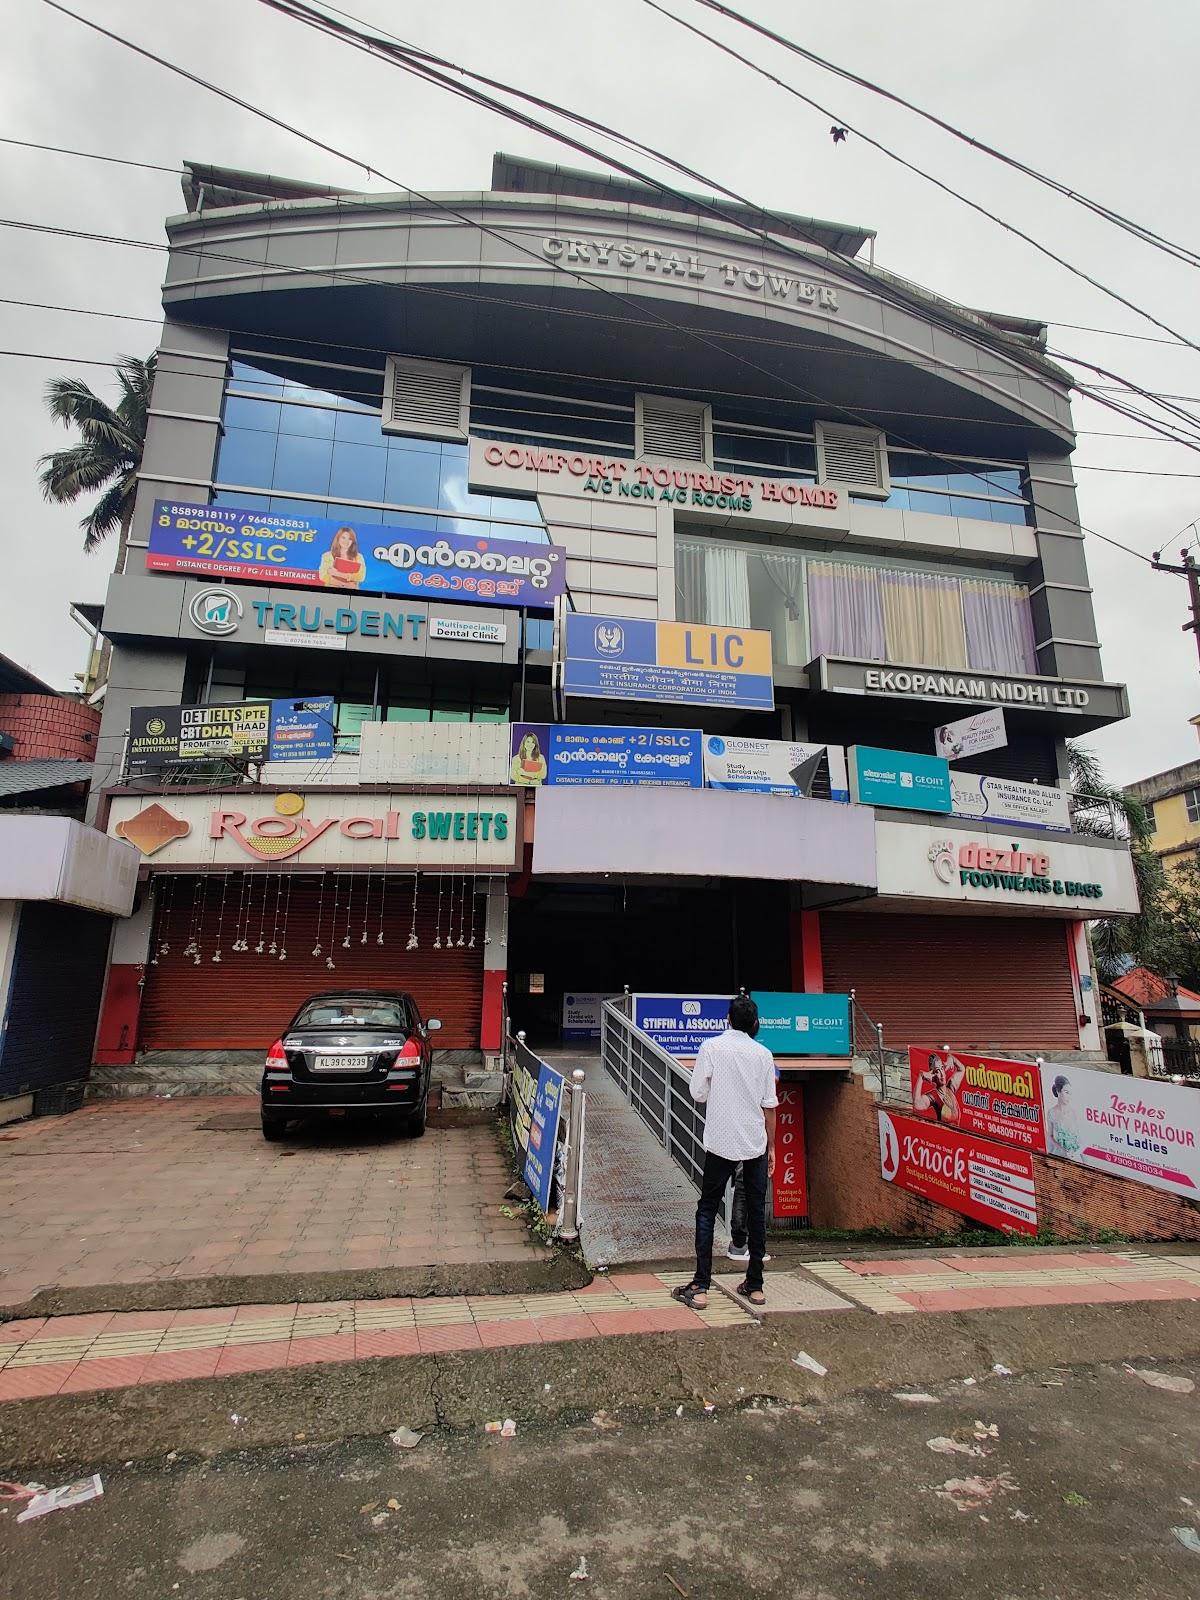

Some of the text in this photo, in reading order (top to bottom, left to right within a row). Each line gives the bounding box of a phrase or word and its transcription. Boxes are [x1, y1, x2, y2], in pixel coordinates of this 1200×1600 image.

[543, 236, 840, 312] CRYSTAL TOWER
[484, 444, 839, 510] COMFORT TOURIST HOME
[584, 477, 753, 513] A/C NON A/C ROOMS
[171, 506, 237, 527] 8589818119
[248, 515, 311, 530] 9645835831
[158, 515, 318, 545] 8 മാസം കൊണ്ട്
[181, 532, 289, 563] +2/SSLC
[176, 560, 212, 570] DISTANCE
[213, 563, 241, 574] DEGREE
[247, 566, 258, 575] PG
[280, 569, 316, 580] ENTRANCE
[409, 571, 525, 597] കോളേജ്
[252, 600, 426, 640] TRU-DENT
[437, 620, 499, 633] Multispeciality
[437, 628, 499, 641] Dental Clinic
[685, 630, 744, 667] LIC
[600, 671, 737, 690] भारतीय जीवन बीमा निगम
[865, 670, 1090, 707] EKOPANAM NIDHI LTD
[616, 681, 657, 690] INSURANCE
[657, 684, 706, 694] CORPORATION
[718, 689, 737, 697] INDIA
[183, 708, 266, 724] OET IELTS PTE
[180, 725, 233, 739] CBT DHA
[236, 722, 266, 732] HAAD
[962, 726, 1001, 741] BEAUTY PARLOUR
[132, 736, 178, 748] AJINORAH
[655, 735, 691, 747] SSLC
[726, 740, 769, 751] GLOBNEST
[978, 734, 994, 742] LADIES
[131, 744, 178, 754] INSTITUTIONS
[248, 745, 263, 753] BLS
[633, 751, 693, 767] കോളേജ്
[727, 762, 746, 770] Study
[556, 776, 583, 784] DISTANCE
[584, 777, 605, 785] DEGREE
[915, 775, 944, 786] GEOJIT
[954, 790, 983, 805] STAR
[986, 782, 1061, 800] STAR HEALTH AND ALLIED
[997, 791, 1032, 804] INSURANCE
[411, 810, 508, 841] SWEETS
[209, 811, 401, 861] Royal
[959, 841, 1050, 876] dezire
[960, 870, 1104, 899] FOOTWEARS & BAGS
[642, 1017, 677, 1030] STIFFIN
[678, 1019, 685, 1030] &
[812, 1018, 844, 1026] GEOJIT
[652, 1034, 688, 1043] Chartered
[320, 1057, 366, 1067] KL 39 C 9239
[1110, 1094, 1166, 1121] Lashes
[972, 1117, 1033, 1145] PH: 9048097755
[1086, 1107, 1196, 1148] BEAUTY PARLOUR
[779, 1089, 797, 1185] Knock
[1109, 1133, 1124, 1144] For
[1126, 1133, 1168, 1156] Ladies
[902, 1135, 967, 1184] Knock
[906, 1165, 924, 1181] Boutique
[928, 1174, 950, 1192] Stitching
[950, 1183, 967, 1196] Centre
[984, 1181, 1004, 1194] MATERIAL
[777, 1188, 798, 1197] Boutique
[778, 1196, 801, 1204] Stitching
